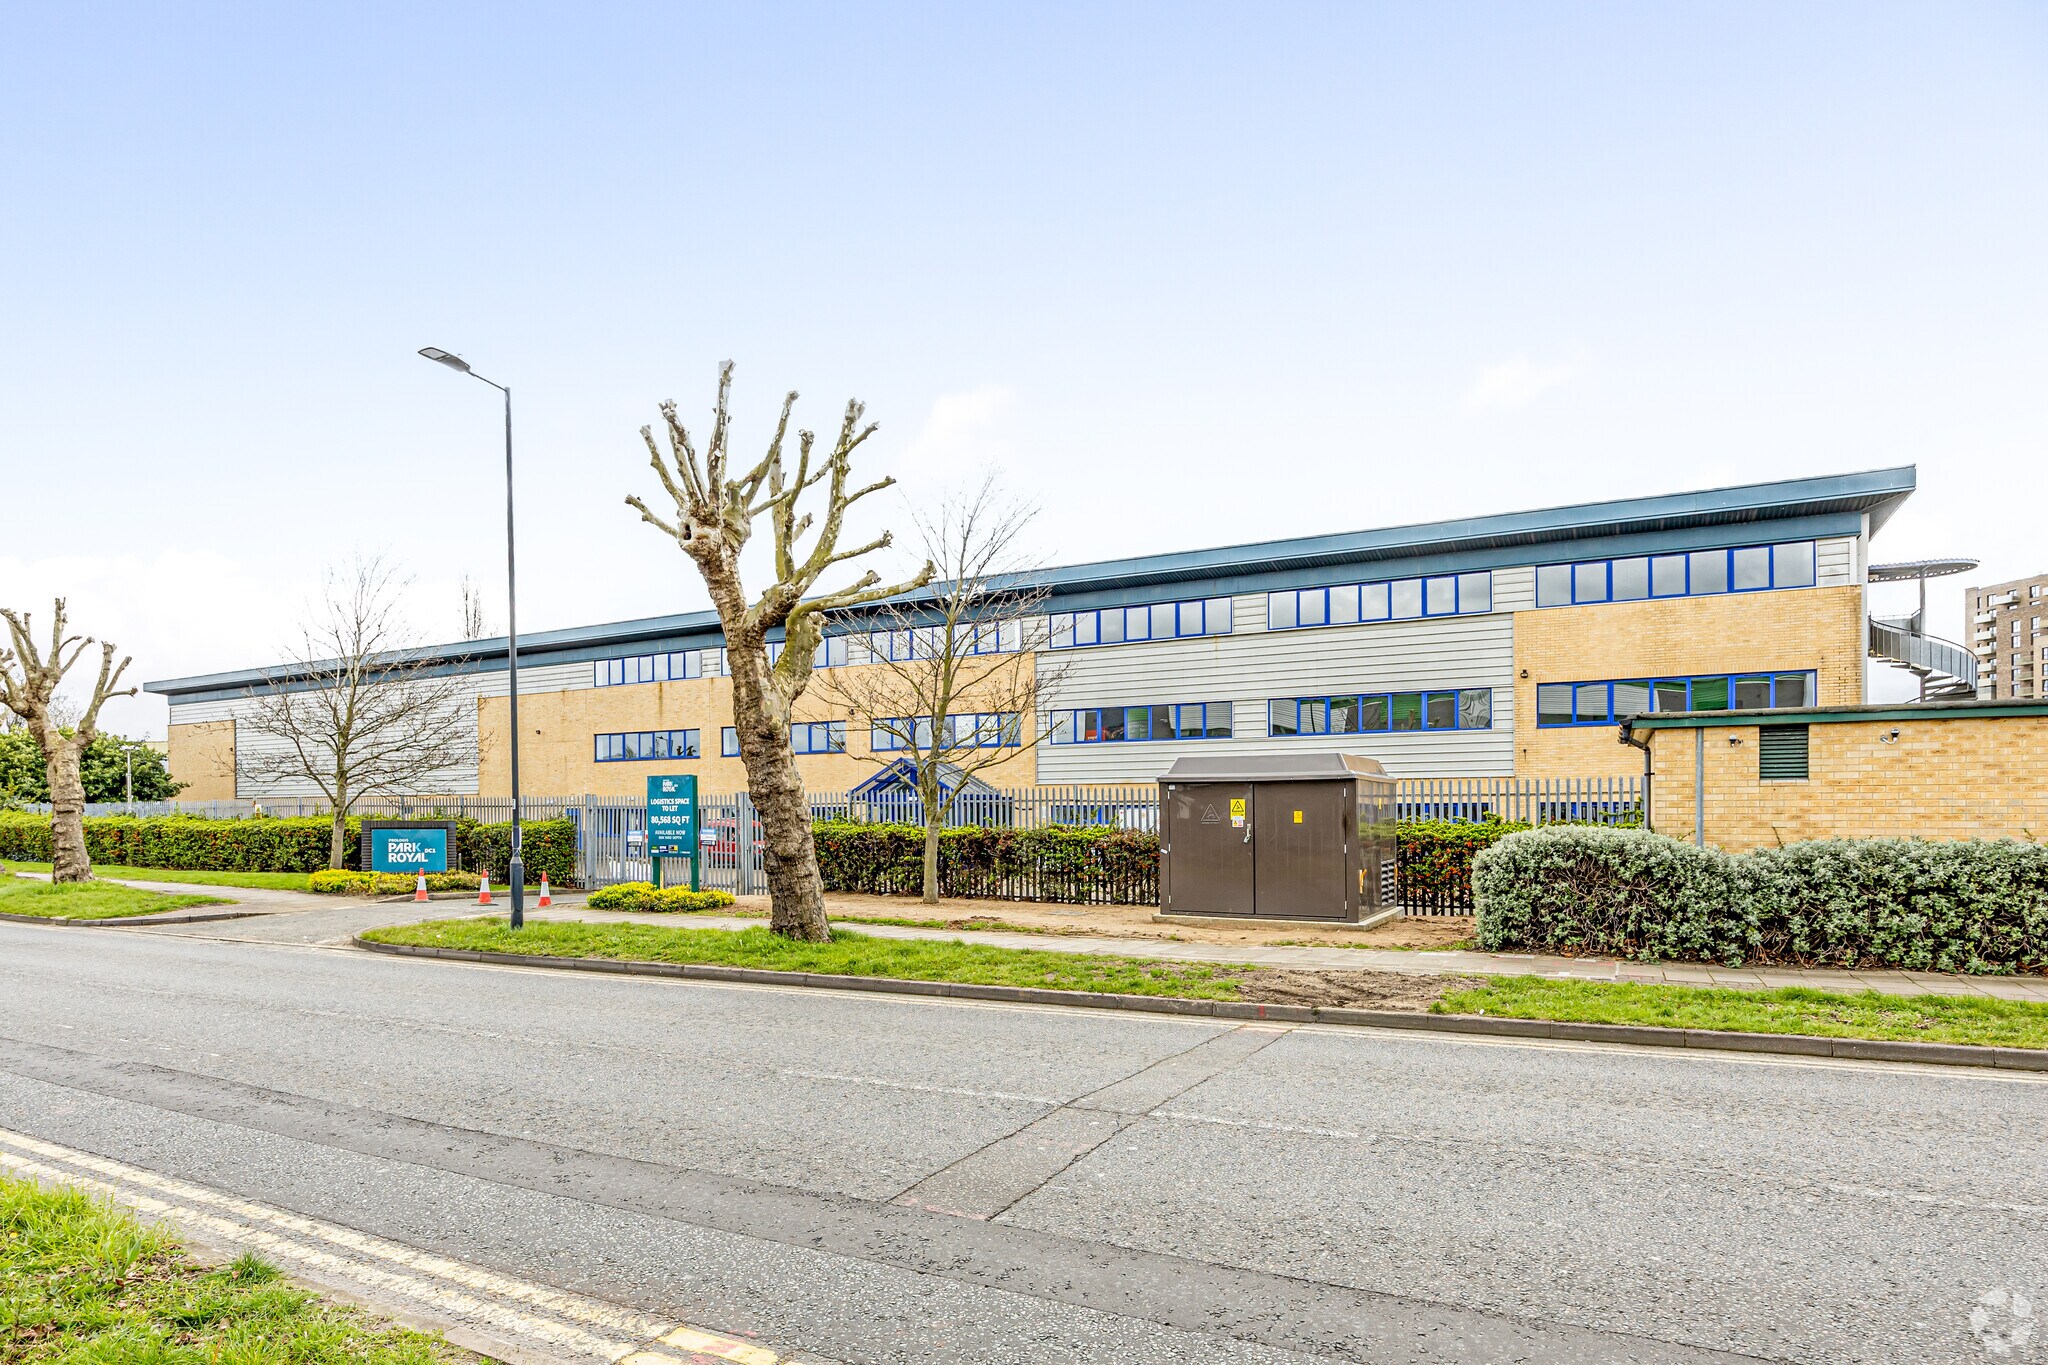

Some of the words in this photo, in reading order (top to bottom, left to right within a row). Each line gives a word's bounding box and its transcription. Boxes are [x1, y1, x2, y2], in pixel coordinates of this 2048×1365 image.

[651, 816, 671, 825] 80,568
[672, 816, 681, 825] SQ
[682, 816, 690, 824] FT
[388, 843, 422, 852] PARK
[388, 853, 428, 863] ROYAL
